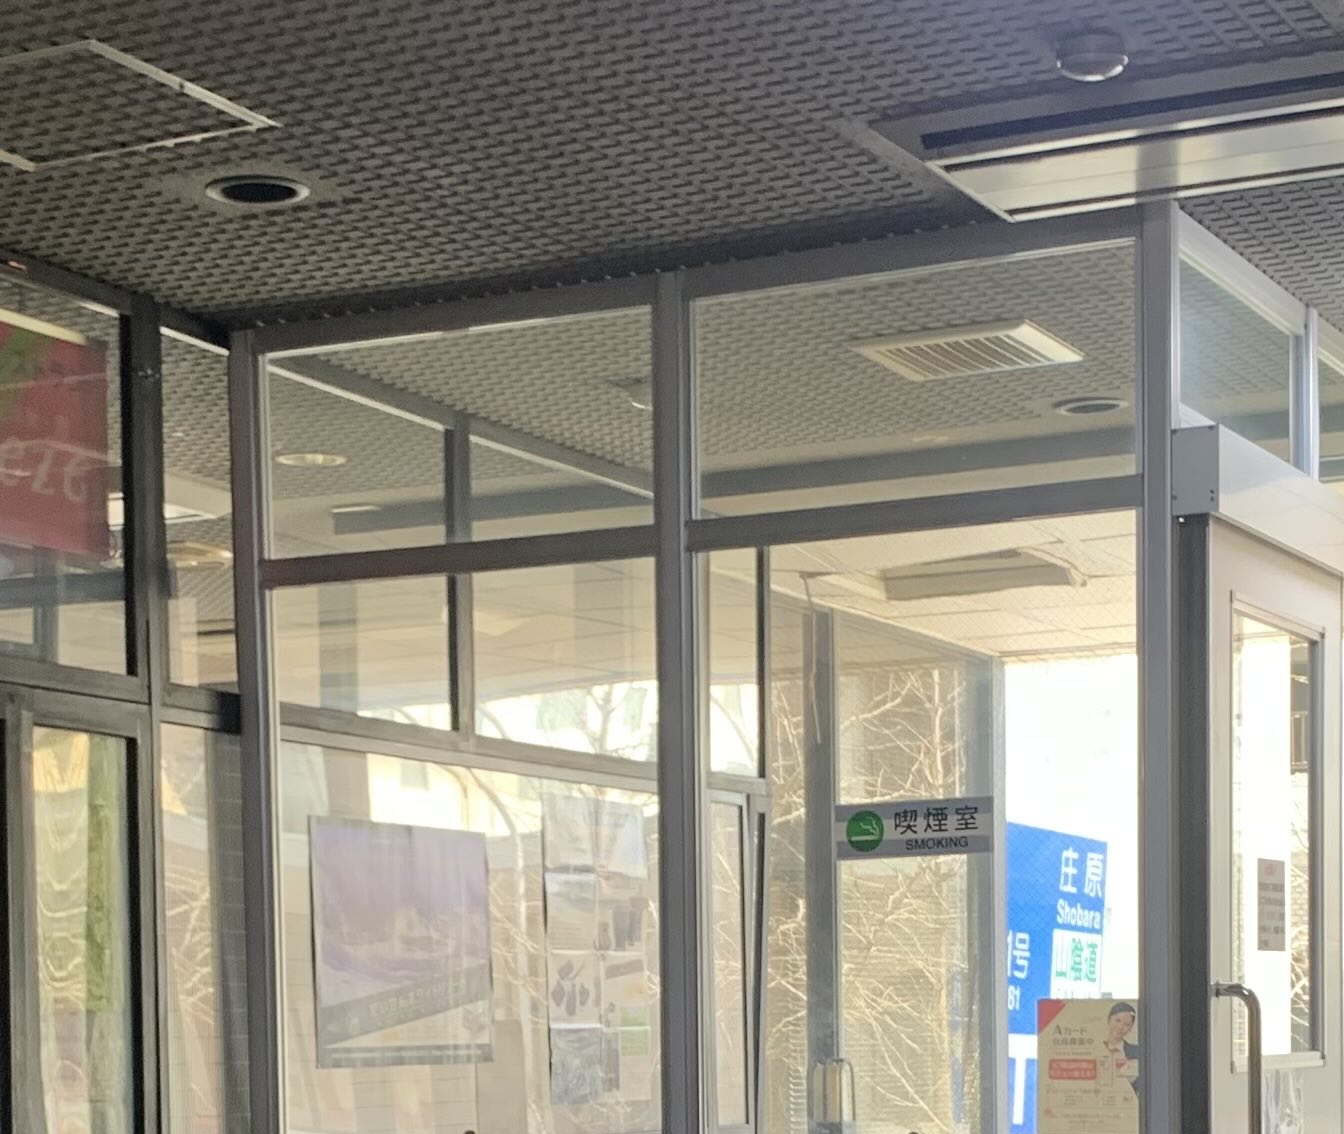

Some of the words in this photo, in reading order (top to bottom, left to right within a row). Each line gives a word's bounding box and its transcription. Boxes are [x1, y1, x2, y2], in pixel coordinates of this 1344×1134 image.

[894, 804, 979, 835] 喫煙室
[905, 836, 969, 851] SMOKING
[1059, 848, 1104, 898] 庄原
[1057, 899, 1101, 929] Shobara
